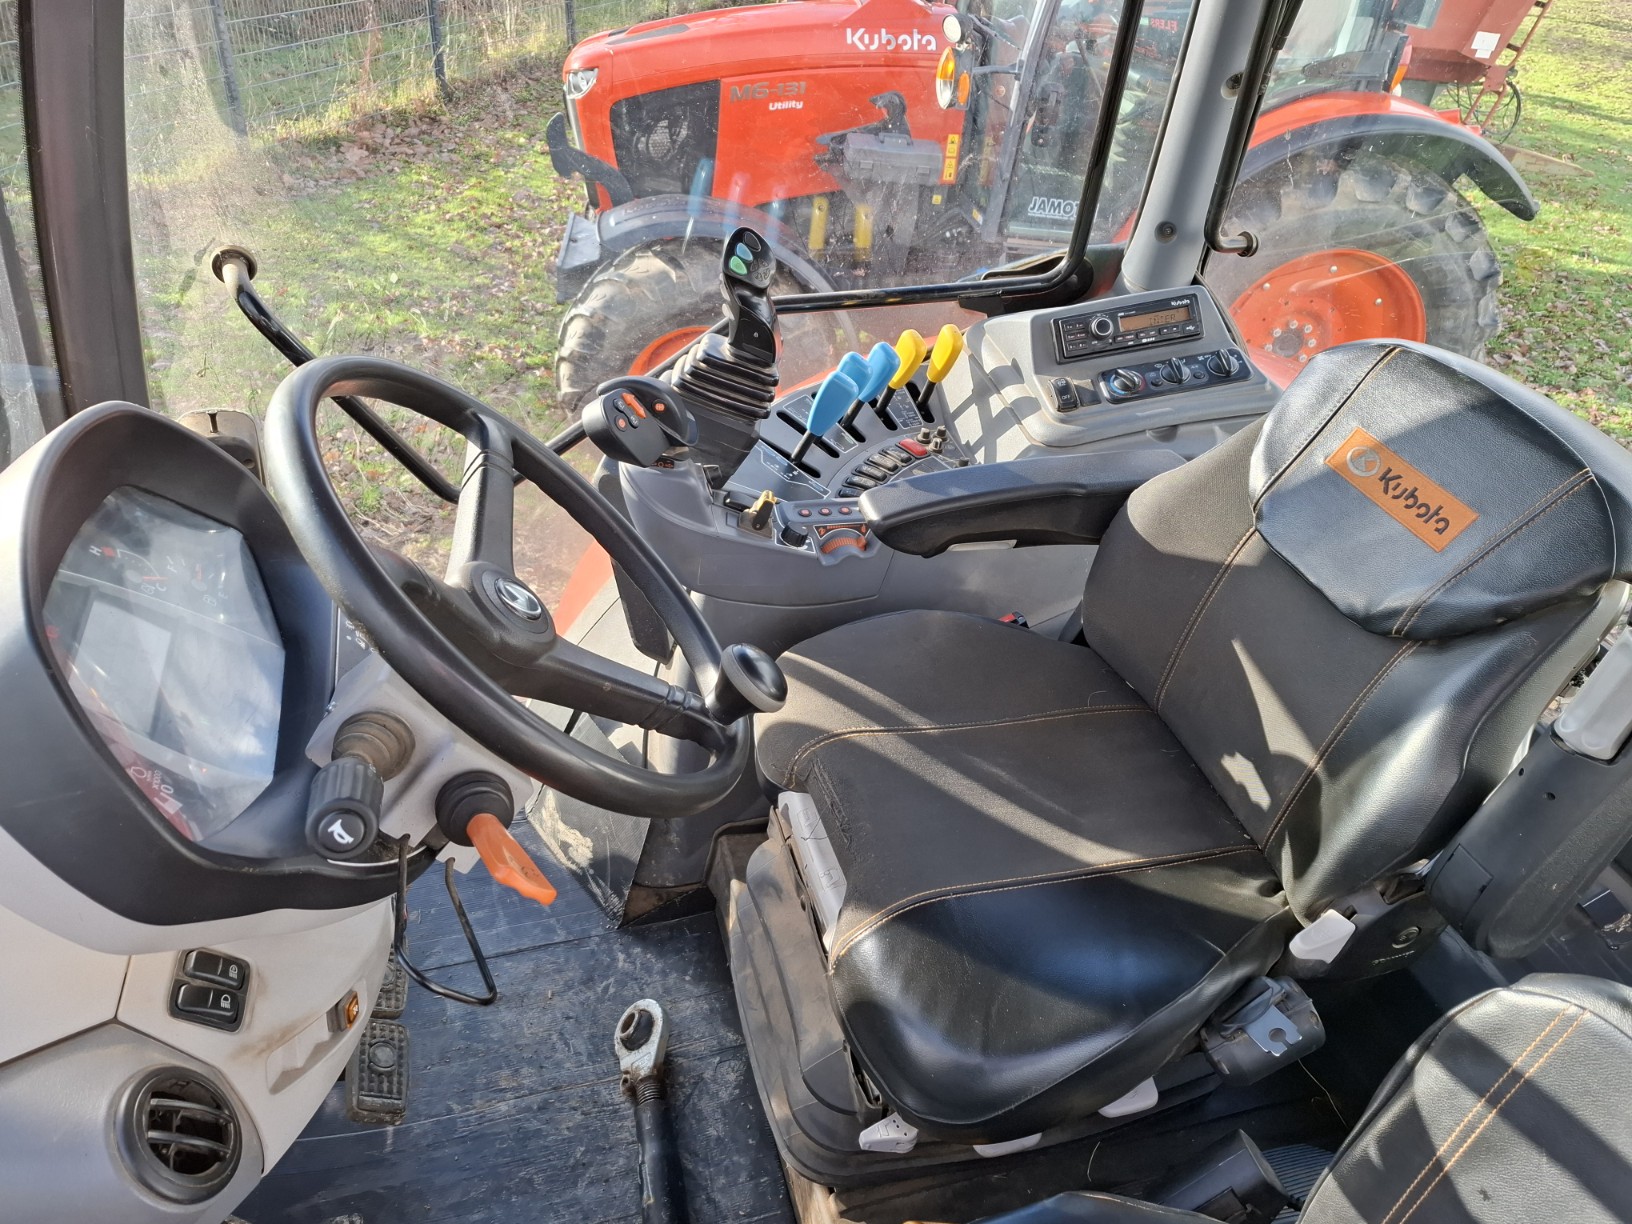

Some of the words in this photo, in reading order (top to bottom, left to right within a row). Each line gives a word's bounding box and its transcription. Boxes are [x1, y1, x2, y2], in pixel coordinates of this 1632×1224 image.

[846, 27, 937, 51] Kubota
[730, 81, 807, 103] M6-131
[768, 99, 804, 111] Utility
[1378, 467, 1450, 535] Kubota
